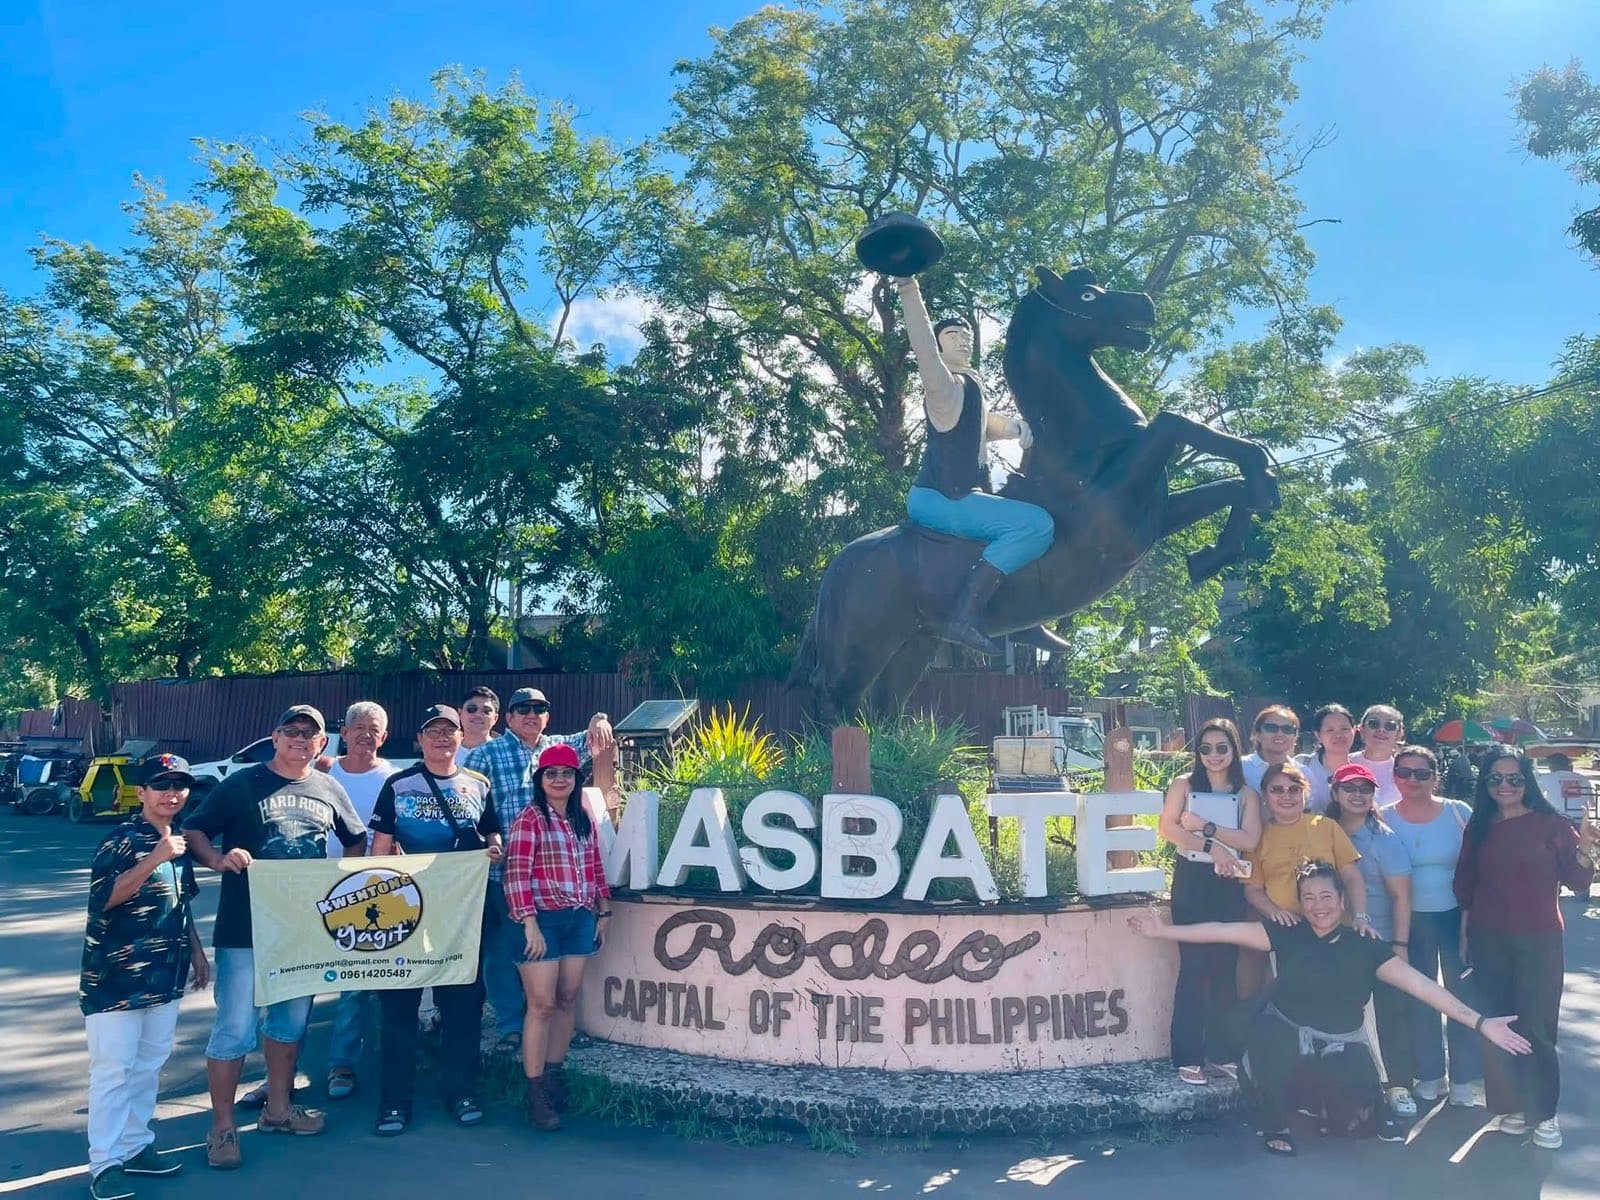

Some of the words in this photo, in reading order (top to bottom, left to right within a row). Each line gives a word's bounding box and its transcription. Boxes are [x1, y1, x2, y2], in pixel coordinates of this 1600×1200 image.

[258, 795, 296, 824] HARD
[582, 787, 1164, 901] MASBATE
[316, 873, 412, 915] KWENTONG
[279, 958, 390, 975] kwentongyagit@gmail.com
[654, 908, 1041, 984] Rodeo
[340, 969, 412, 980] 09614205487
[604, 976, 725, 1030] CAPITAL
[749, 988, 794, 1037] OF
[811, 992, 884, 1043] THE
[904, 989, 1129, 1045] PHILIPPINES
